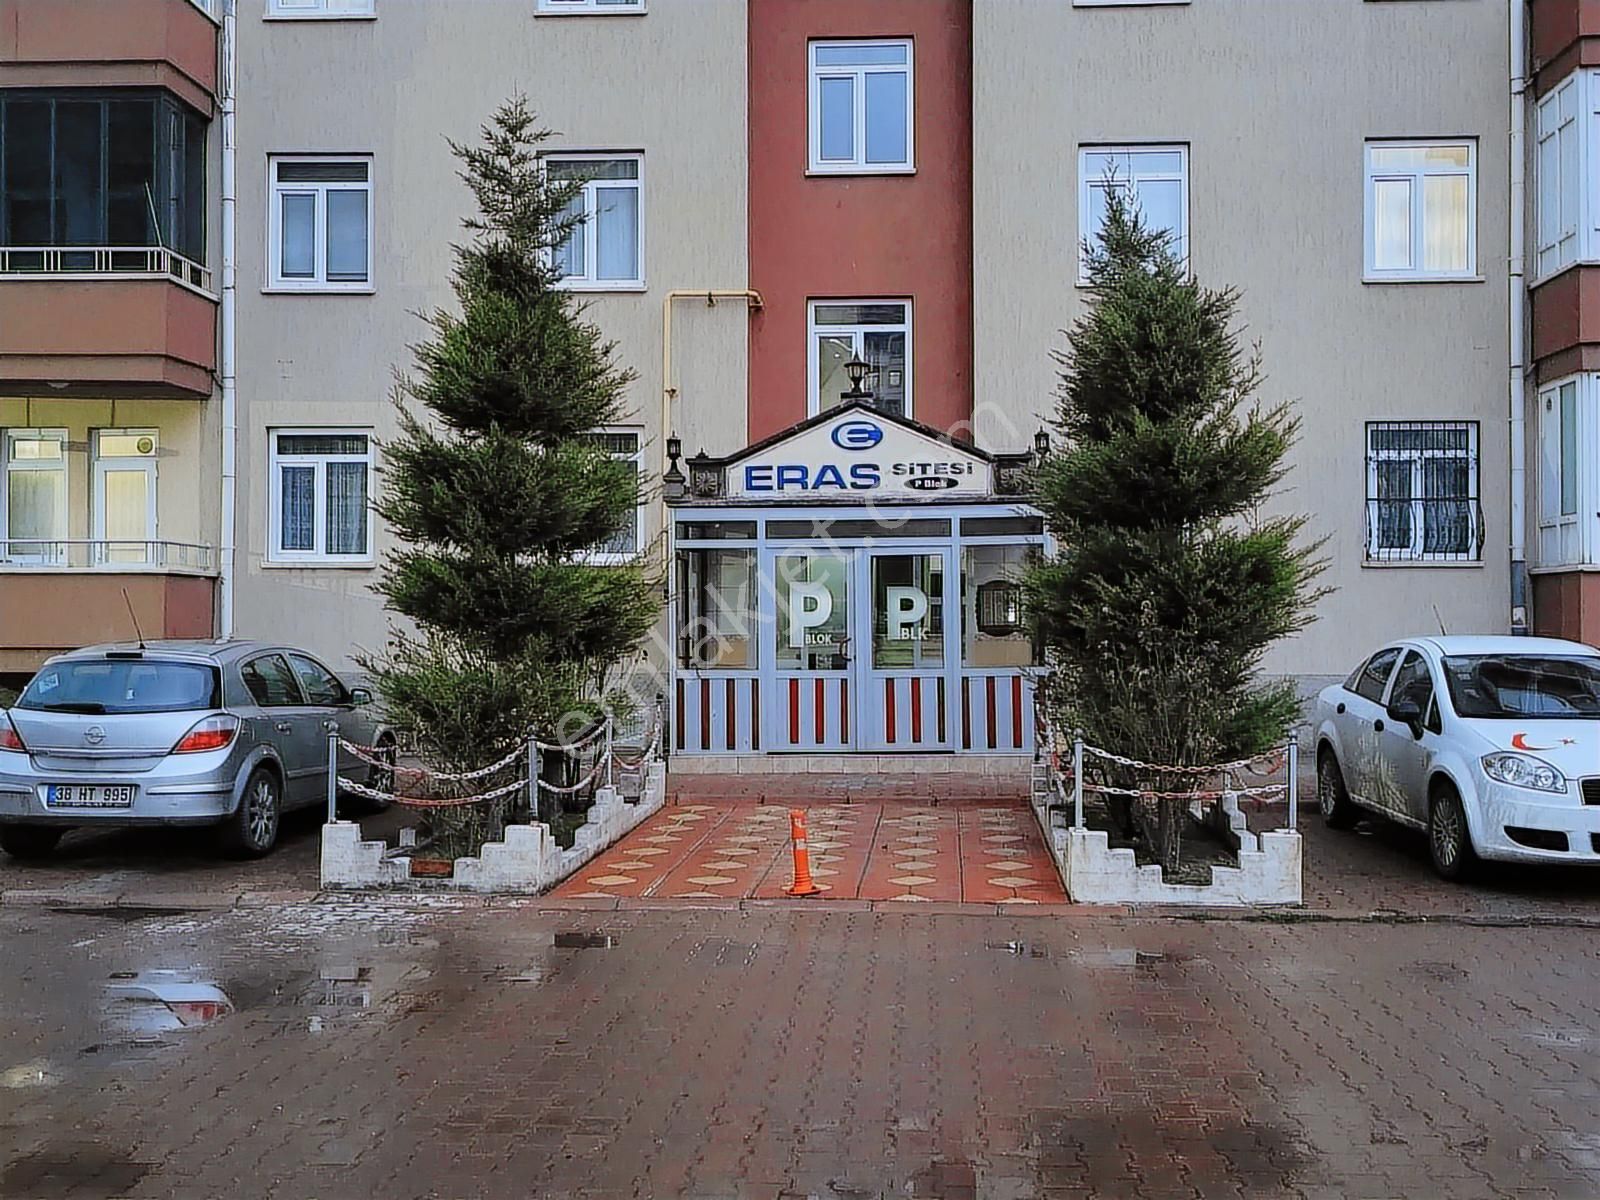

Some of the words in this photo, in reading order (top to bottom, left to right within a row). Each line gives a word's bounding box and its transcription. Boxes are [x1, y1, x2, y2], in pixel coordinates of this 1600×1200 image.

[745, 463, 881, 491] ERAS
[789, 581, 832, 648] P
[887, 586, 928, 640] P
[805, 633, 832, 645] BLOK
[56, 787, 72, 801] 38
[79, 788, 96, 801] HT
[103, 788, 129, 801] 995
